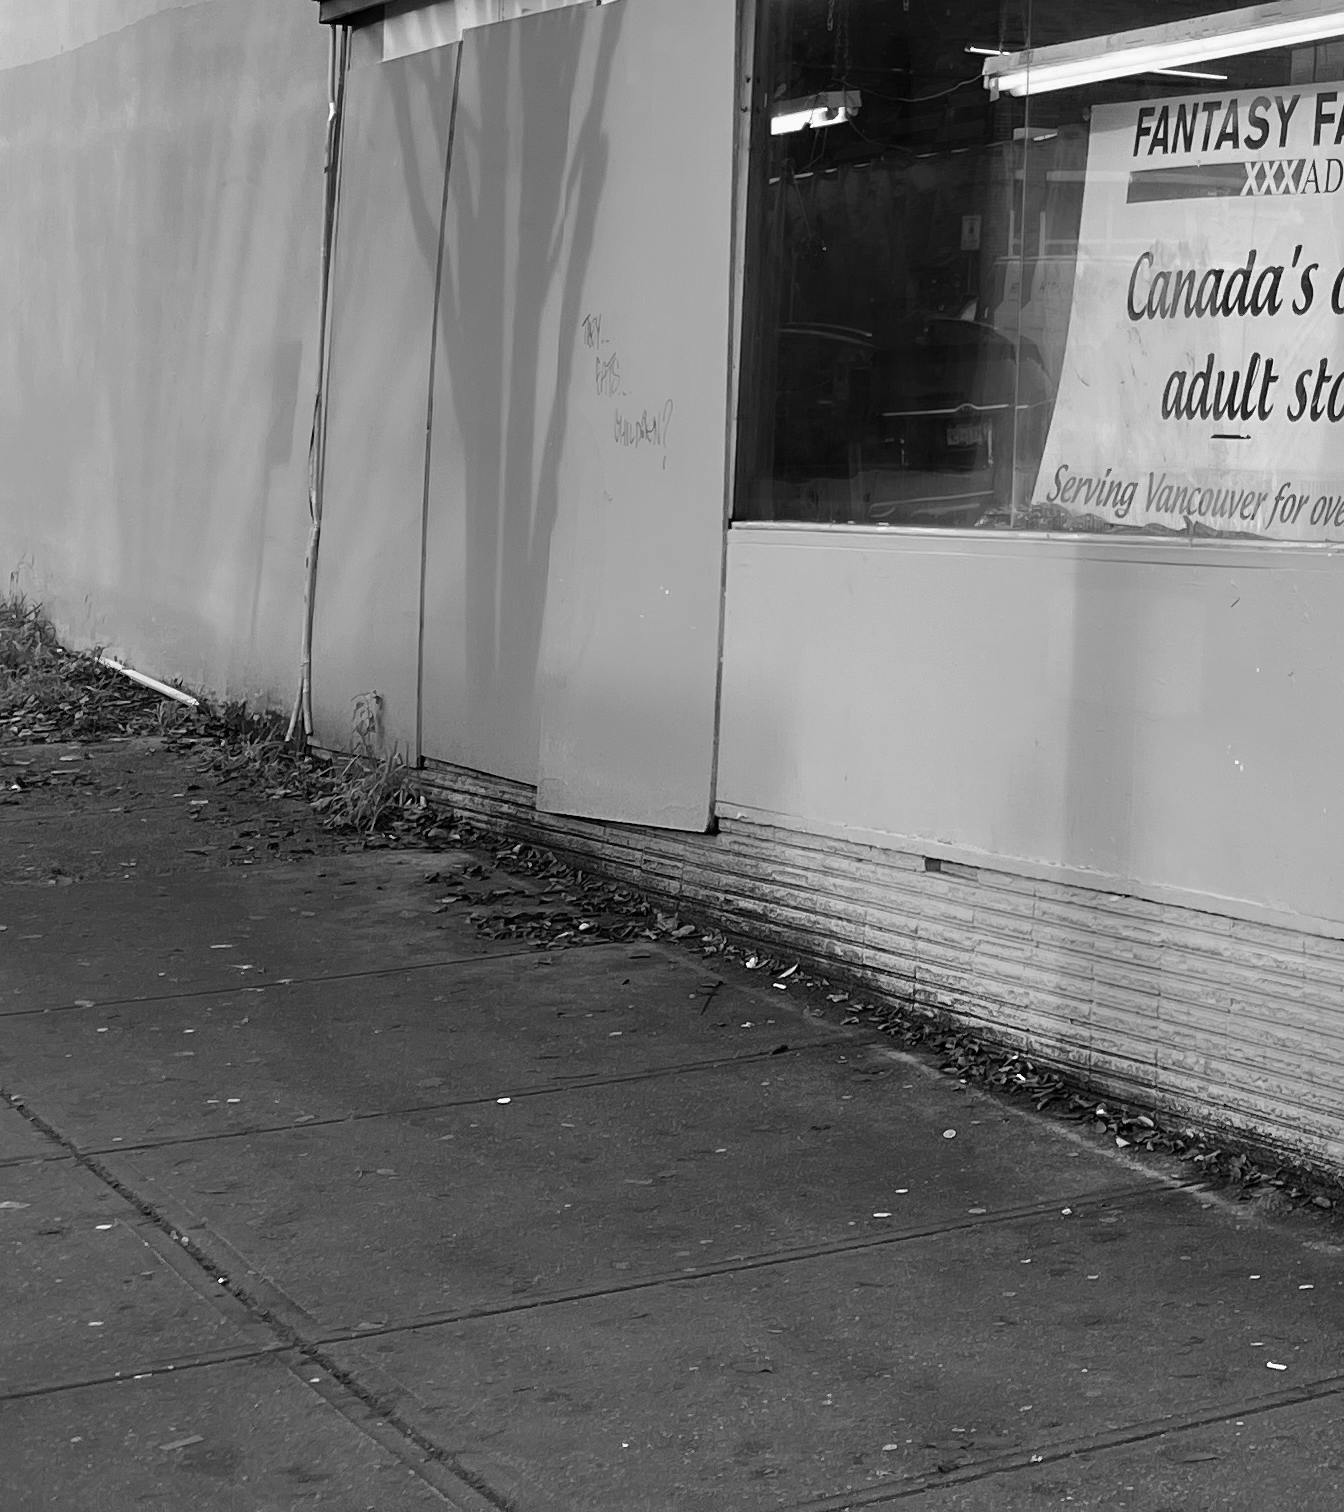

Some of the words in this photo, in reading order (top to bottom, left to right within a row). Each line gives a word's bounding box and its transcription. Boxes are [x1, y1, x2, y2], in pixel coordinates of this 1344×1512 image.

[1132, 95, 1300, 158] FANTASY
[1127, 244, 1319, 321] Canada's
[1161, 352, 1279, 422] adult
[1046, 464, 1139, 519] Serving
[1144, 471, 1269, 521] Vancouver
[1264, 482, 1309, 529] for
